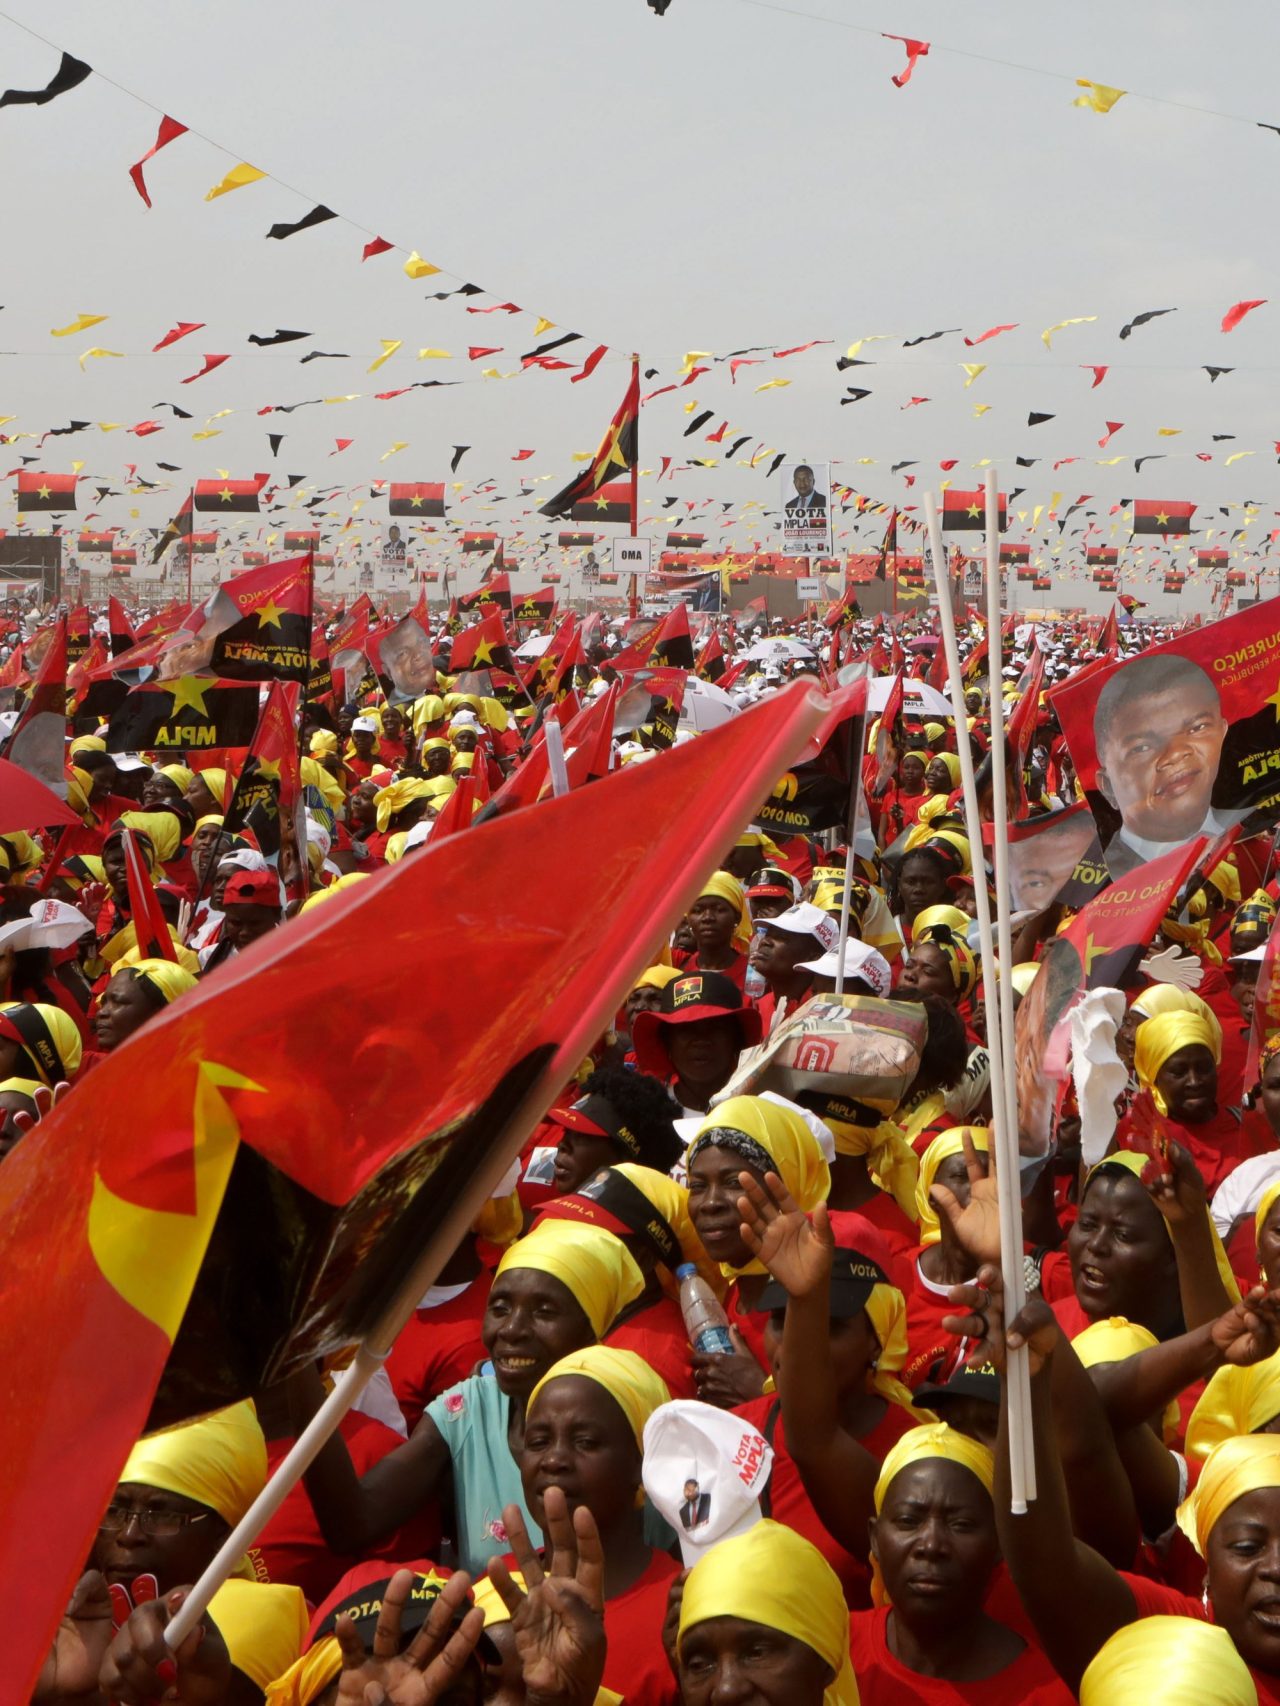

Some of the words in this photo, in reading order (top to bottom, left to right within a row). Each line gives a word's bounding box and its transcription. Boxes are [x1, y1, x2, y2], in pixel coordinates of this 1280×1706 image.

[785, 508, 826, 518] VOTA
[784, 520, 809, 528] MPLA
[621, 550, 642, 560] OMA
[815, 924, 833, 947] MPLA
[819, 923, 833, 937] VOTA
[861, 964, 880, 987] MPLA
[869, 962, 882, 978] VOTA
[673, 992, 701, 1007] MPLA
[37, 1039, 56, 1069] MPLA
[556, 1108, 577, 1123] PLA
[827, 1101, 857, 1120] MPLA
[618, 1126, 641, 1154] MPLA
[560, 1199, 595, 1219] MPLA
[647, 1219, 673, 1253] MPLA
[850, 1262, 878, 1278] VOTA
[732, 1434, 751, 1467] VOTA
[739, 1435, 768, 1486] MPLA
[248, 1548, 271, 1584] Ango
